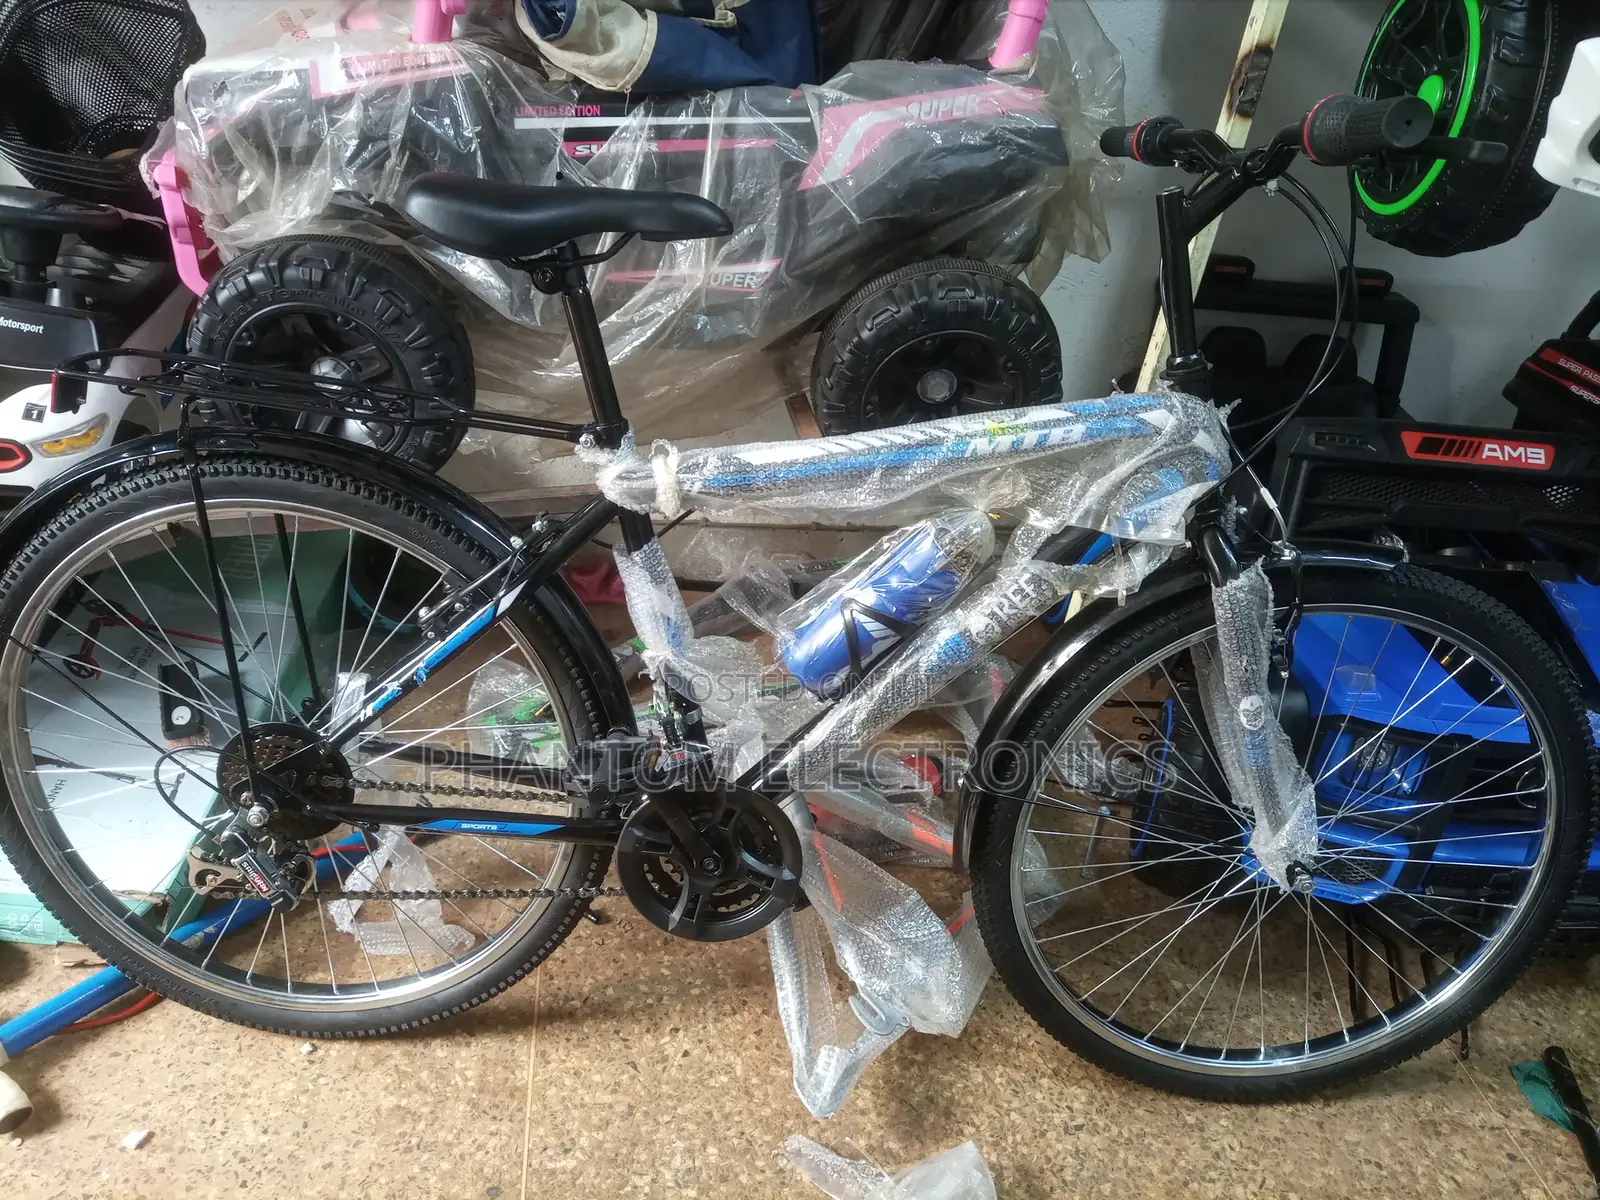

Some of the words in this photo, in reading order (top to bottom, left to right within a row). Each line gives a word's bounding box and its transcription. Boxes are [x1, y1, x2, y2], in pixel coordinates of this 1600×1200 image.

[515, 105, 557, 117] LIMITED
[906, 93, 979, 122] SUPER
[574, 142, 660, 155] SUPR
[705, 272, 758, 288] UPER
[1557, 358, 1583, 374] SUPER
[31, 409, 39, 419] 1
[964, 424, 1086, 458] MTB
[461, 822, 498, 831] SPORTS
